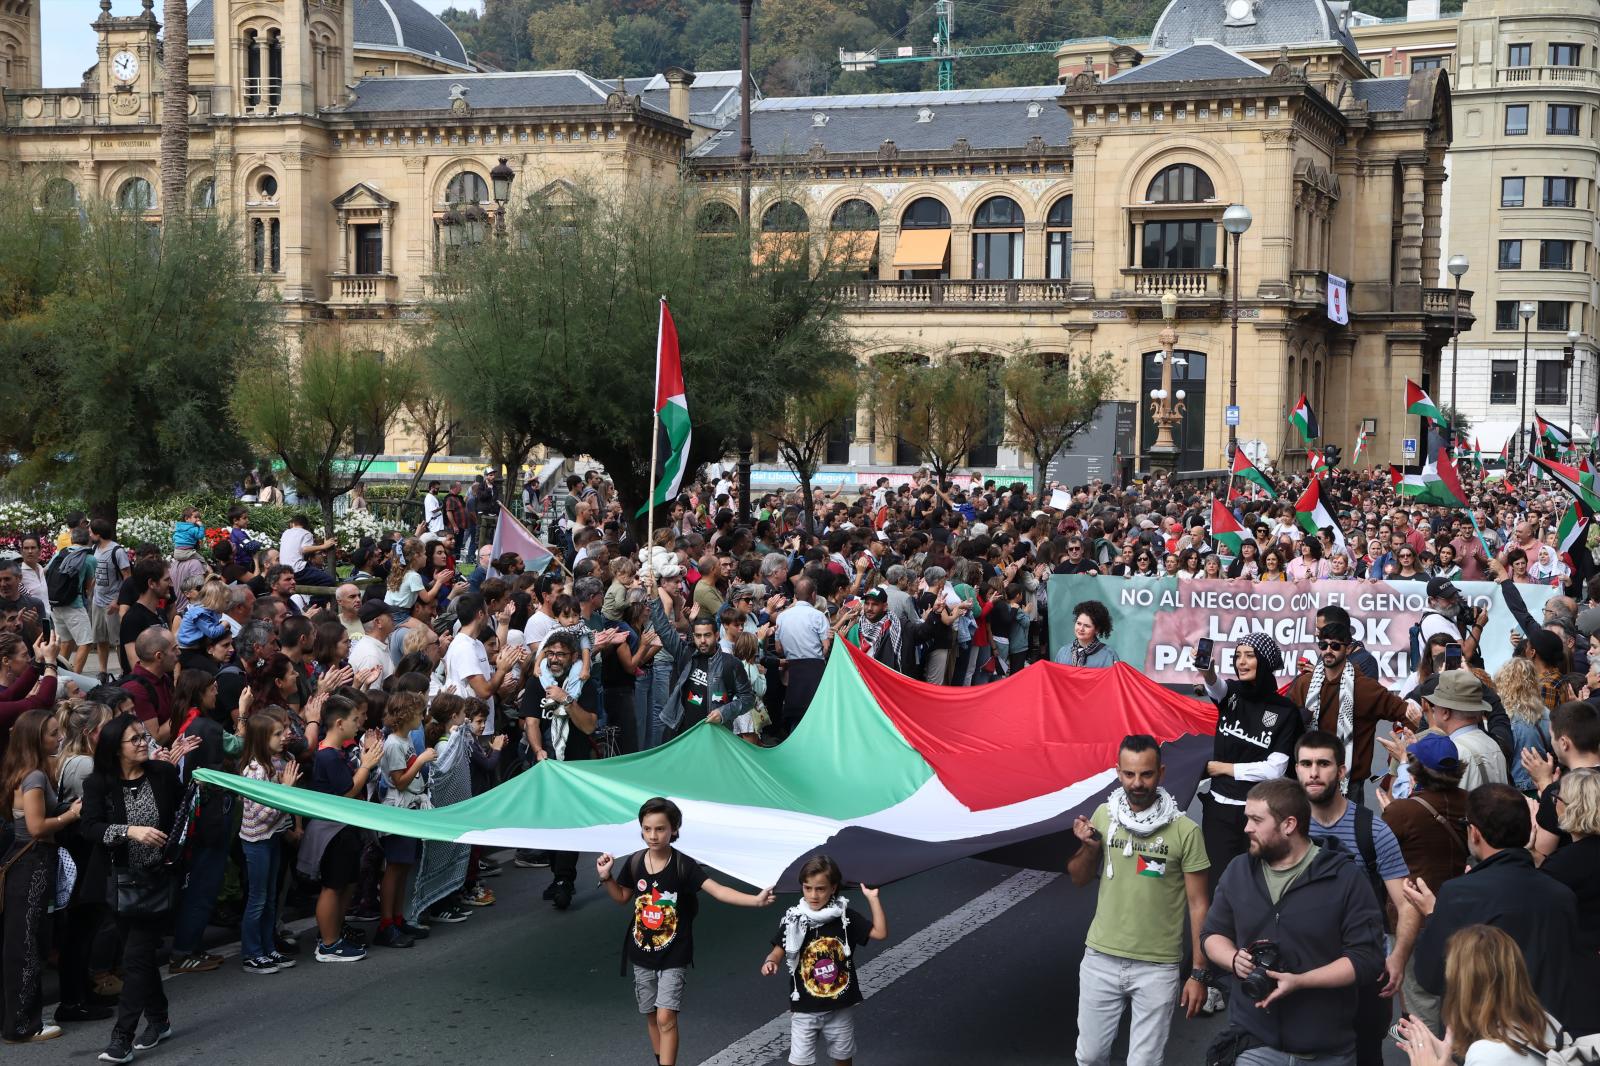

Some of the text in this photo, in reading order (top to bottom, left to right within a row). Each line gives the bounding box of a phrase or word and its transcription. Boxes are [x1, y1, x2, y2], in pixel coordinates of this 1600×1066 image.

[1121, 589, 1493, 612] NO AL NEGOCIO CON EL GENOIO
[1209, 615, 1392, 646] LANGILOK
[1218, 715, 1273, 749] فلسطين
[643, 910, 661, 920] LAB
[814, 964, 835, 976] LAB
